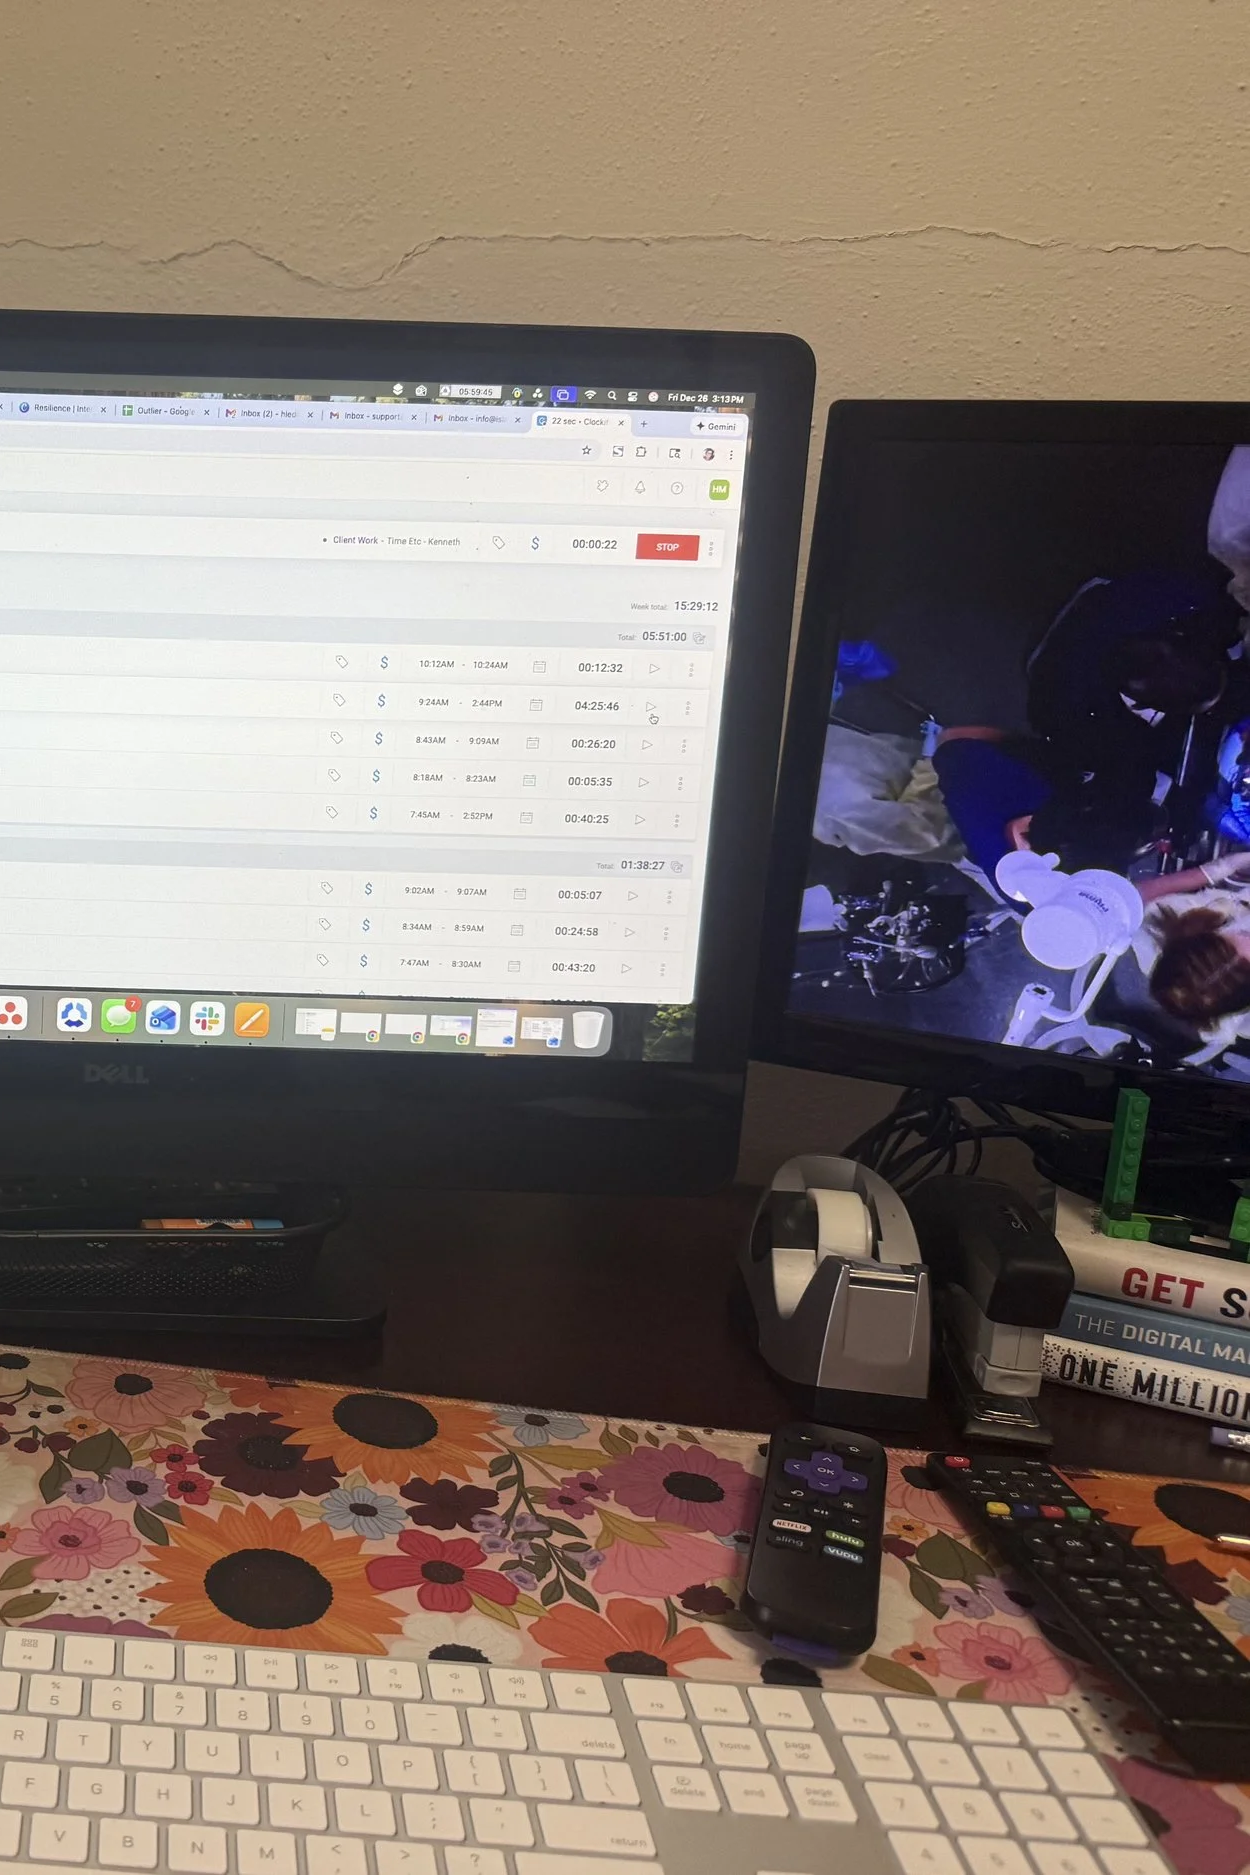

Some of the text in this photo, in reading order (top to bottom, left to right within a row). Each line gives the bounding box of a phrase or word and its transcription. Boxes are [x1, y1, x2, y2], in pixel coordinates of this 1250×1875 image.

[668, 393, 678, 401] Fri
[680, 394, 694, 402] Dec
[698, 394, 708, 402] 26
[34, 403, 71, 413] Resilience
[138, 406, 162, 415] Outlier
[708, 423, 736, 431] Gemini
[713, 484, 726, 493] HM
[333, 535, 460, 547] Client Work Time Etc Kenneth
[573, 538, 618, 550] 00:00:22
[656, 542, 679, 552] STOP
[631, 602, 648, 610] Week
[674, 601, 719, 612] 15:29:12
[642, 631, 687, 642] 05:51:00
[419, 660, 508, 670] 10:12AM 10:24AM
[578, 662, 623, 673] 00:12:32
[472, 699, 502, 708] 2:44PM
[575, 700, 619, 712] 04:25:46
[572, 738, 616, 750] 00:26:20
[568, 776, 612, 787] 00:05:35
[565, 814, 609, 825] 00:40:25
[621, 859, 665, 871] 01:38:27
[405, 887, 487, 897] 9:02AM 9:07AM
[558, 889, 602, 901] 00:05:07
[555, 926, 599, 937] 00:24:58
[552, 962, 596, 973] 00:43:20
[130, 1000, 135, 1008] 7
[84, 1064, 149, 1084] DELL
[1121, 1267, 1204, 1309] GET
[1075, 1313, 1115, 1336] THE
[1121, 1324, 1206, 1355] DIGITAL
[1059, 1354, 1118, 1391] ONE
[817, 1467, 834, 1475] OK
[777, 1521, 807, 1531] NETFLIX
[776, 1536, 804, 1547] sling
[832, 1532, 859, 1545] hulu
[582, 1740, 615, 1750] delete
